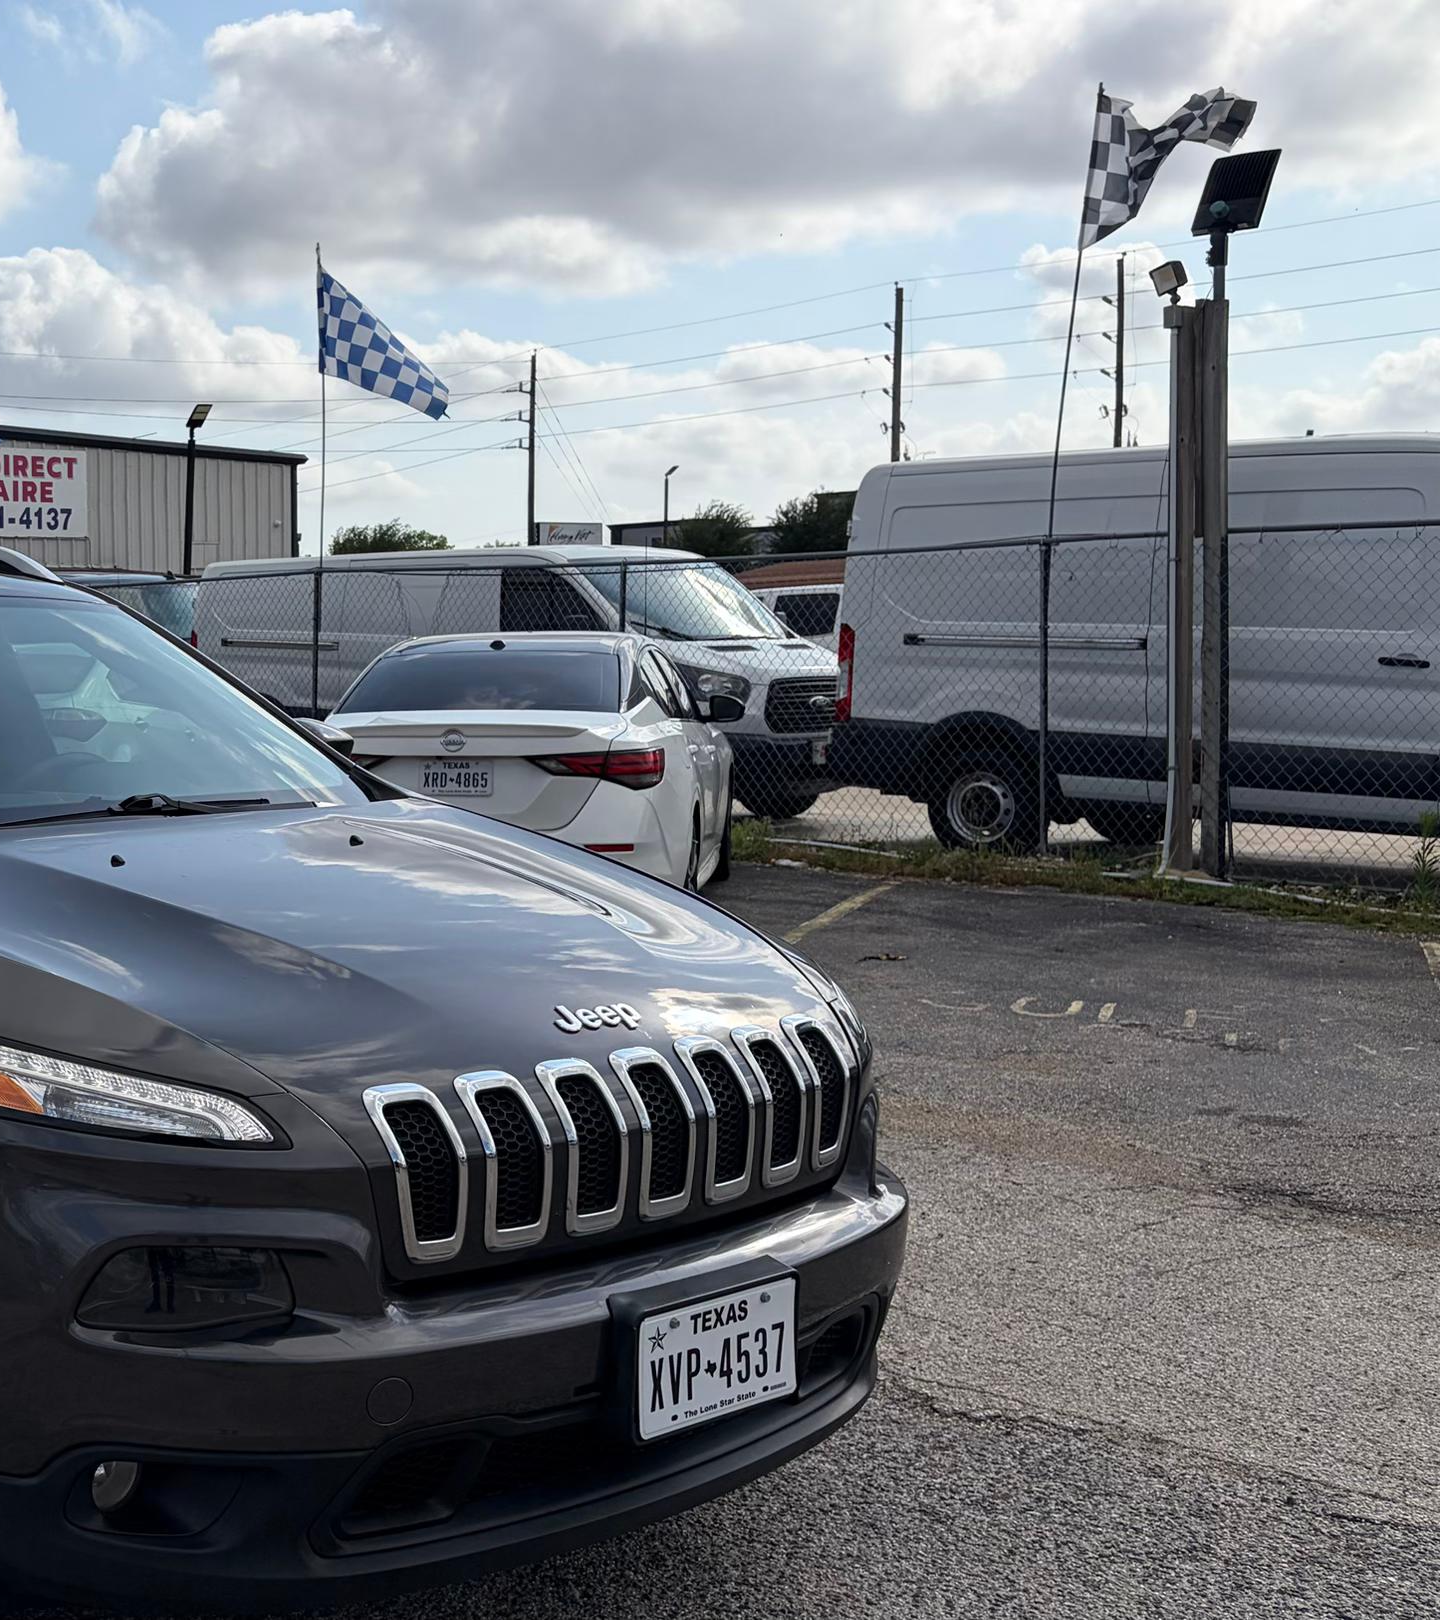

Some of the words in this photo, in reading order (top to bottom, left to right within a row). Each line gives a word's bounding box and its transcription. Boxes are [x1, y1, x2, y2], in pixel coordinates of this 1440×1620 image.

[554, 1002, 642, 1034] Jeep
[690, 1299, 749, 1335] TEXAS
[683, 1408, 698, 1419] The
[699, 1403, 718, 1414] Lone
[719, 1396, 735, 1408] Star
[736, 1390, 757, 1402] State
